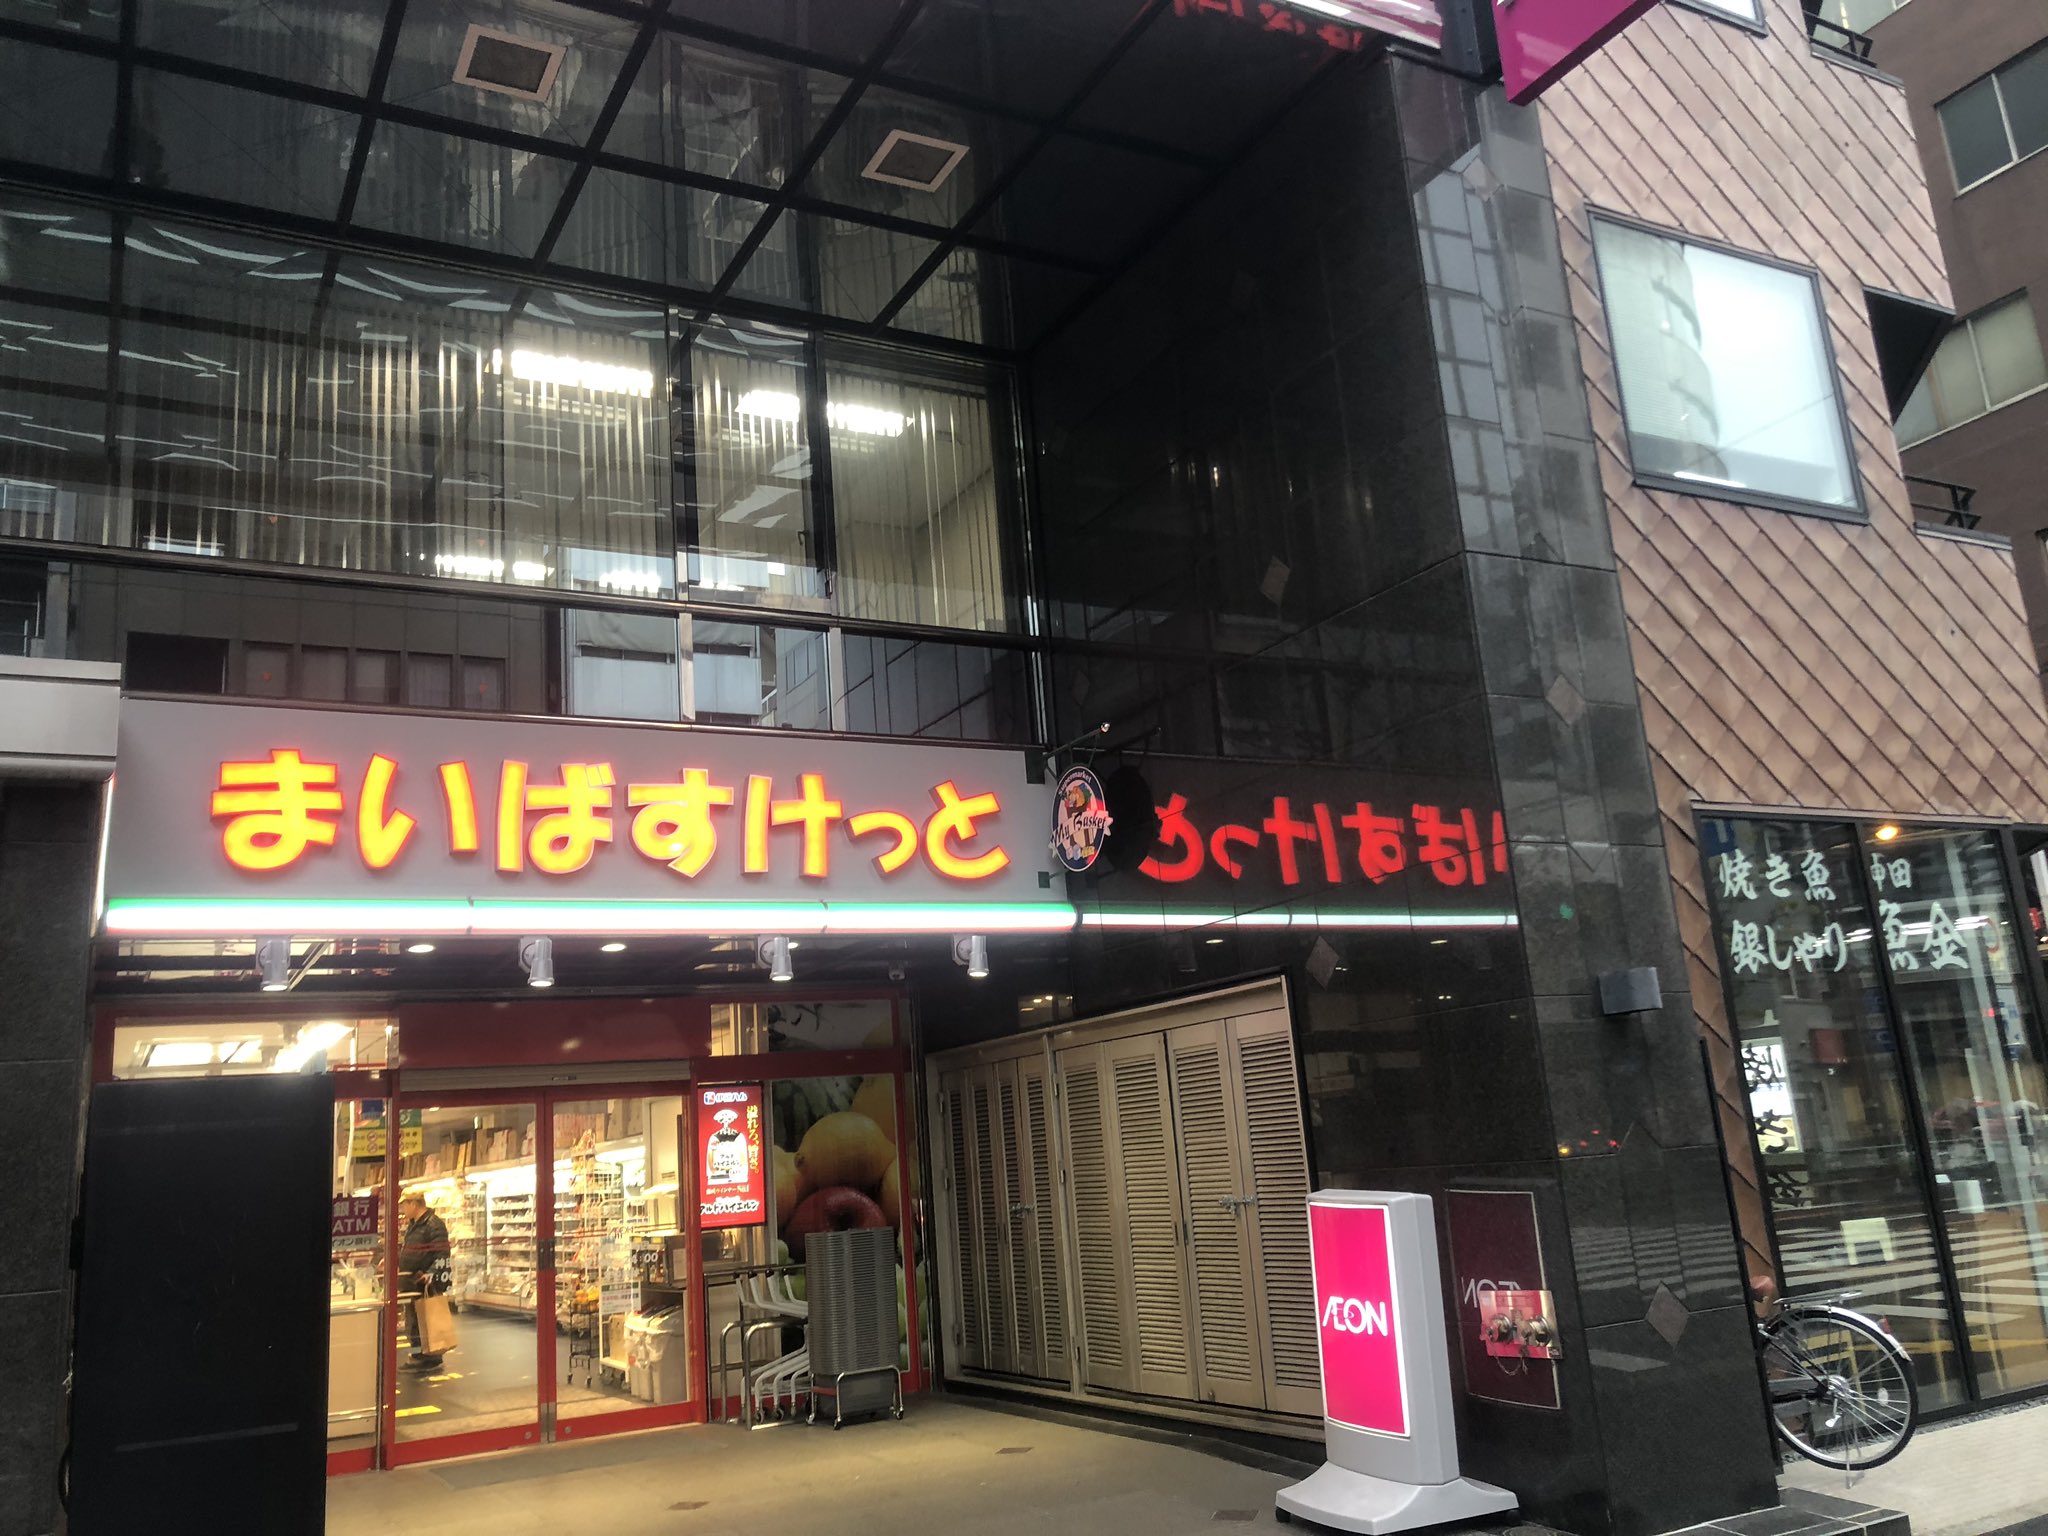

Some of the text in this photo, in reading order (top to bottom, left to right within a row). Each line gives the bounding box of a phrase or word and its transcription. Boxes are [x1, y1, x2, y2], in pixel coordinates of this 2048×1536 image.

[210, 747, 1010, 880] まいばすけっと
[1053, 811, 1107, 848] My Basket
[1719, 848, 1836, 901] 焼き魚
[1730, 919, 1848, 974] 銀しゃり
[332, 1217, 371, 1233] ATM
